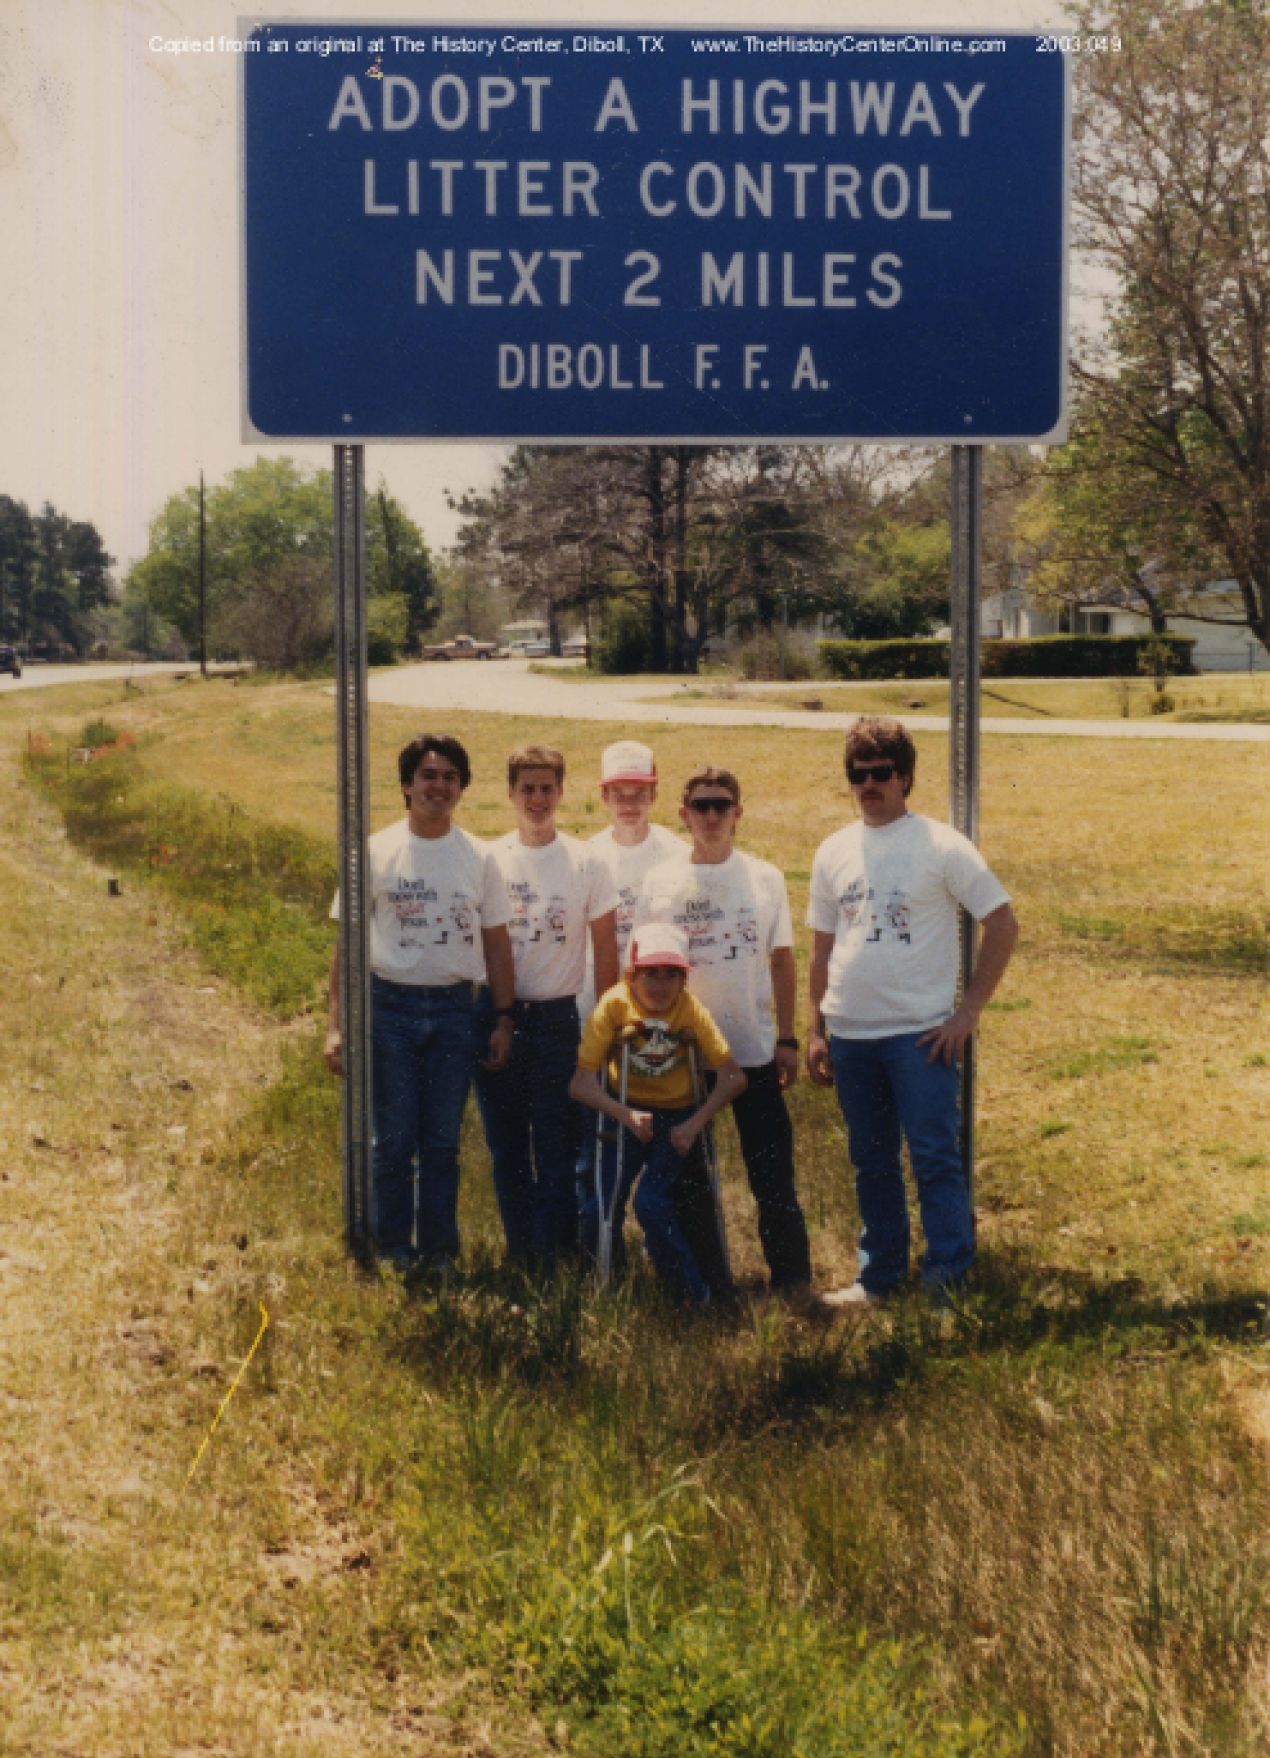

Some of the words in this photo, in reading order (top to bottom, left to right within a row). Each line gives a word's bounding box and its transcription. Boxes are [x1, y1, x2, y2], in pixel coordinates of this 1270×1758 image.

[328, 74, 551, 132] ADOPT
[594, 77, 639, 132] A
[681, 79, 986, 137] HIGHWAY
[364, 159, 600, 217] LITTER
[639, 161, 952, 220] CONTROL
[416, 249, 583, 305] NEXT
[624, 251, 660, 307] 2
[701, 251, 903, 308] MILES
[498, 343, 664, 389] DIBOLL
[696, 344, 721, 389] F.
[744, 344, 769, 389] F.
[793, 346, 829, 389] A.
